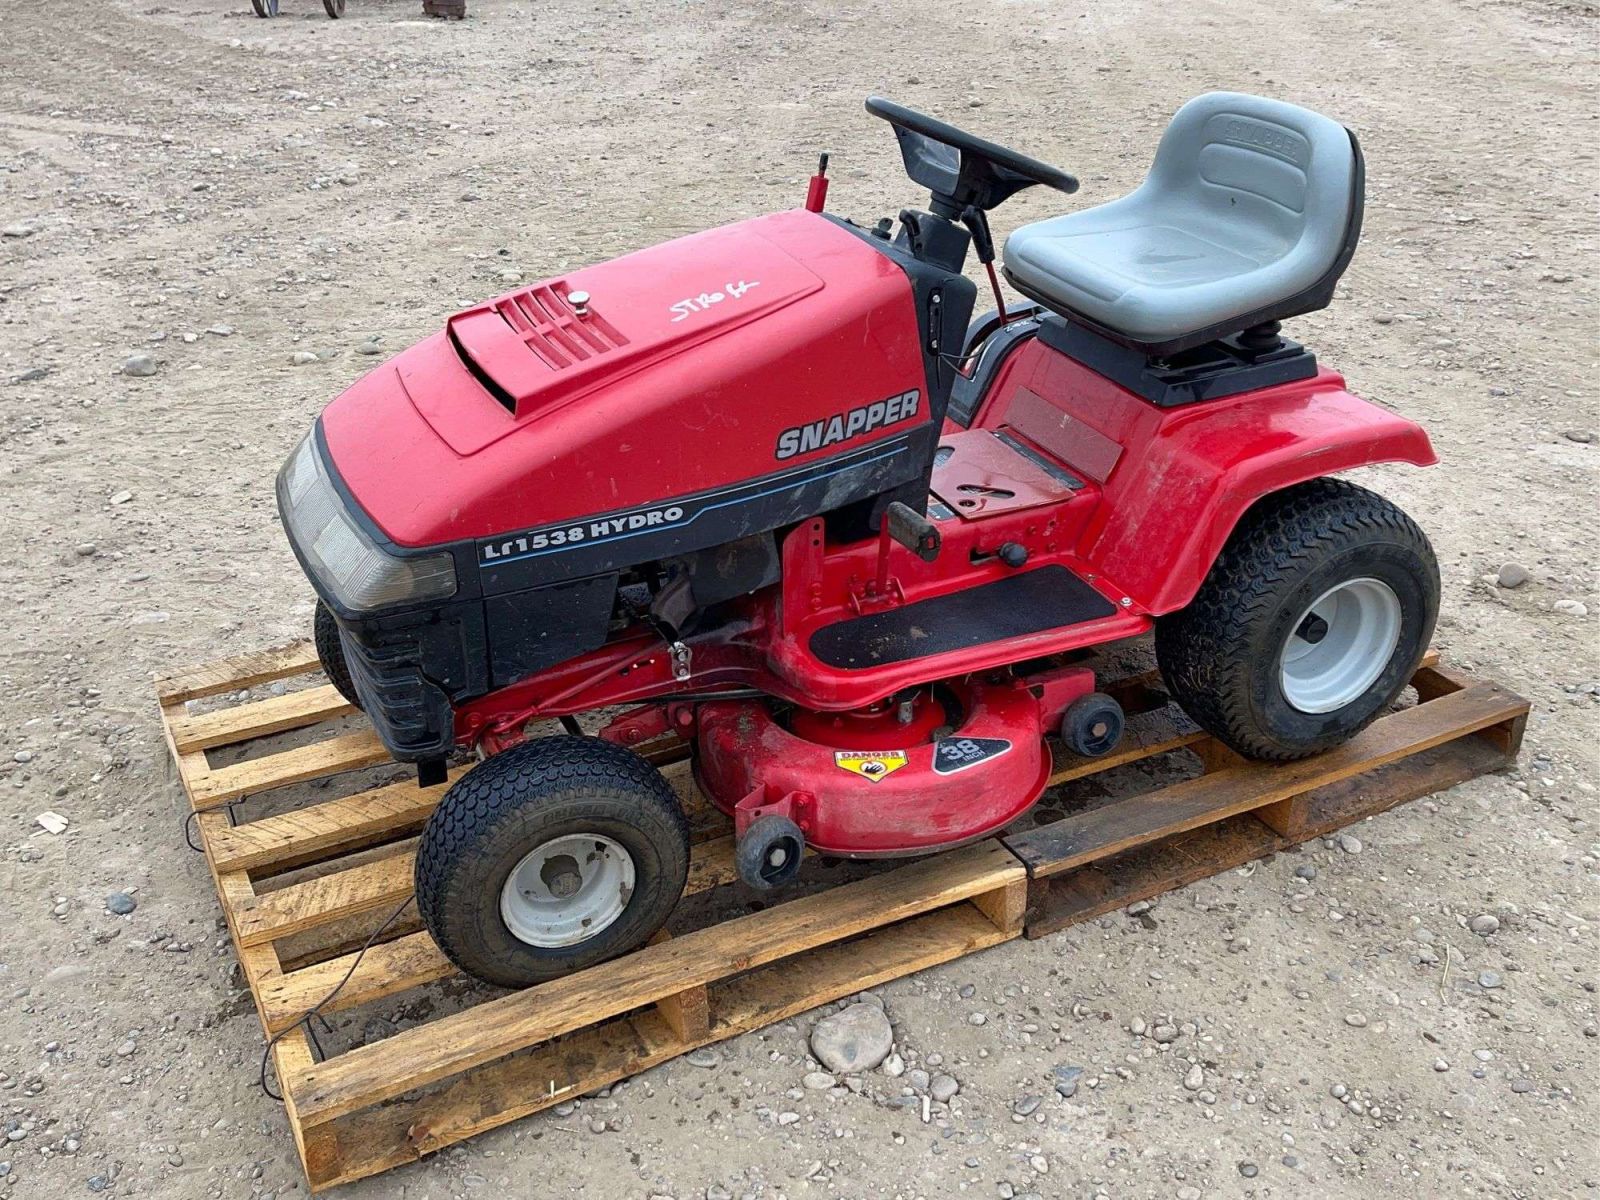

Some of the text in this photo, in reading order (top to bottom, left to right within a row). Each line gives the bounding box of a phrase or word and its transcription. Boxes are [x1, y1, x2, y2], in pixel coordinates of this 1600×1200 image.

[775, 388, 921, 461] SNAPPER
[590, 507, 684, 538] HYDRO
[841, 751, 900, 759] DANGER
[941, 739, 986, 762] 38 INCH
